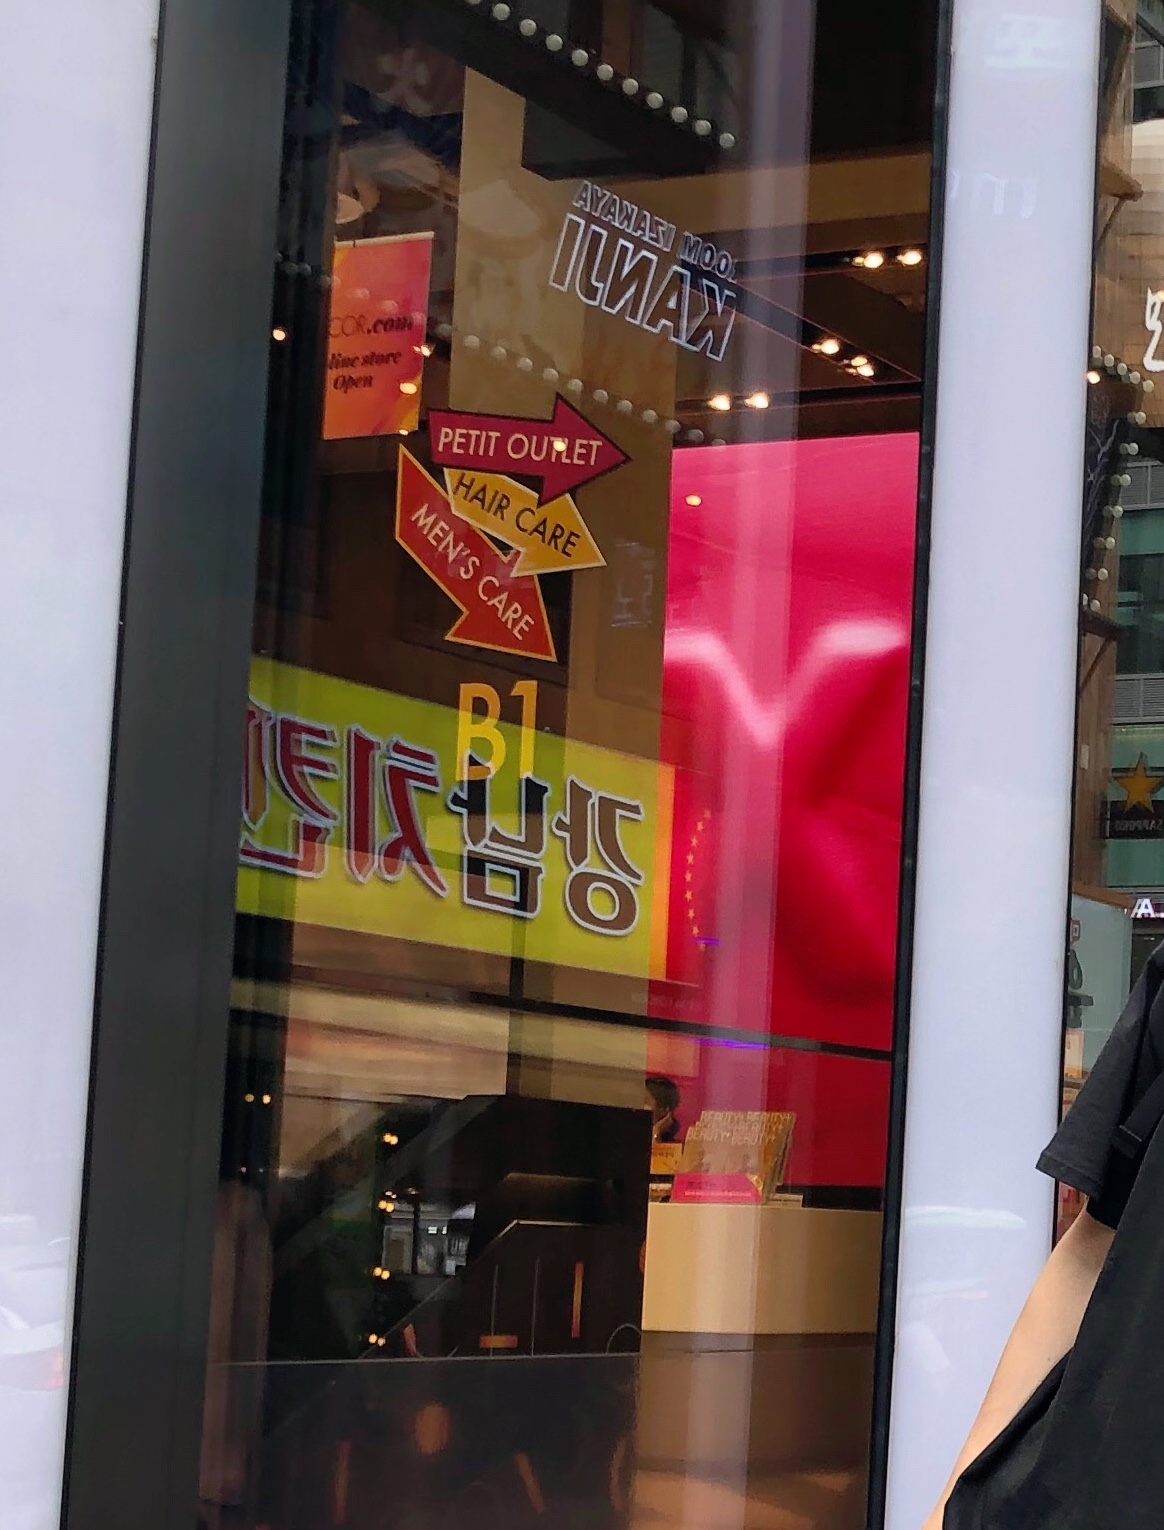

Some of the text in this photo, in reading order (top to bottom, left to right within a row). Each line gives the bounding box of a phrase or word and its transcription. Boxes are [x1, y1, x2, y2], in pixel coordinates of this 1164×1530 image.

[333, 374, 373, 394] Open
[361, 351, 402, 366] store
[437, 426, 603, 466] PETIT OUTLET
[452, 471, 581, 558] HAIR CARE
[411, 503, 535, 641] MEN'S CARE
[455, 679, 539, 781] B1
